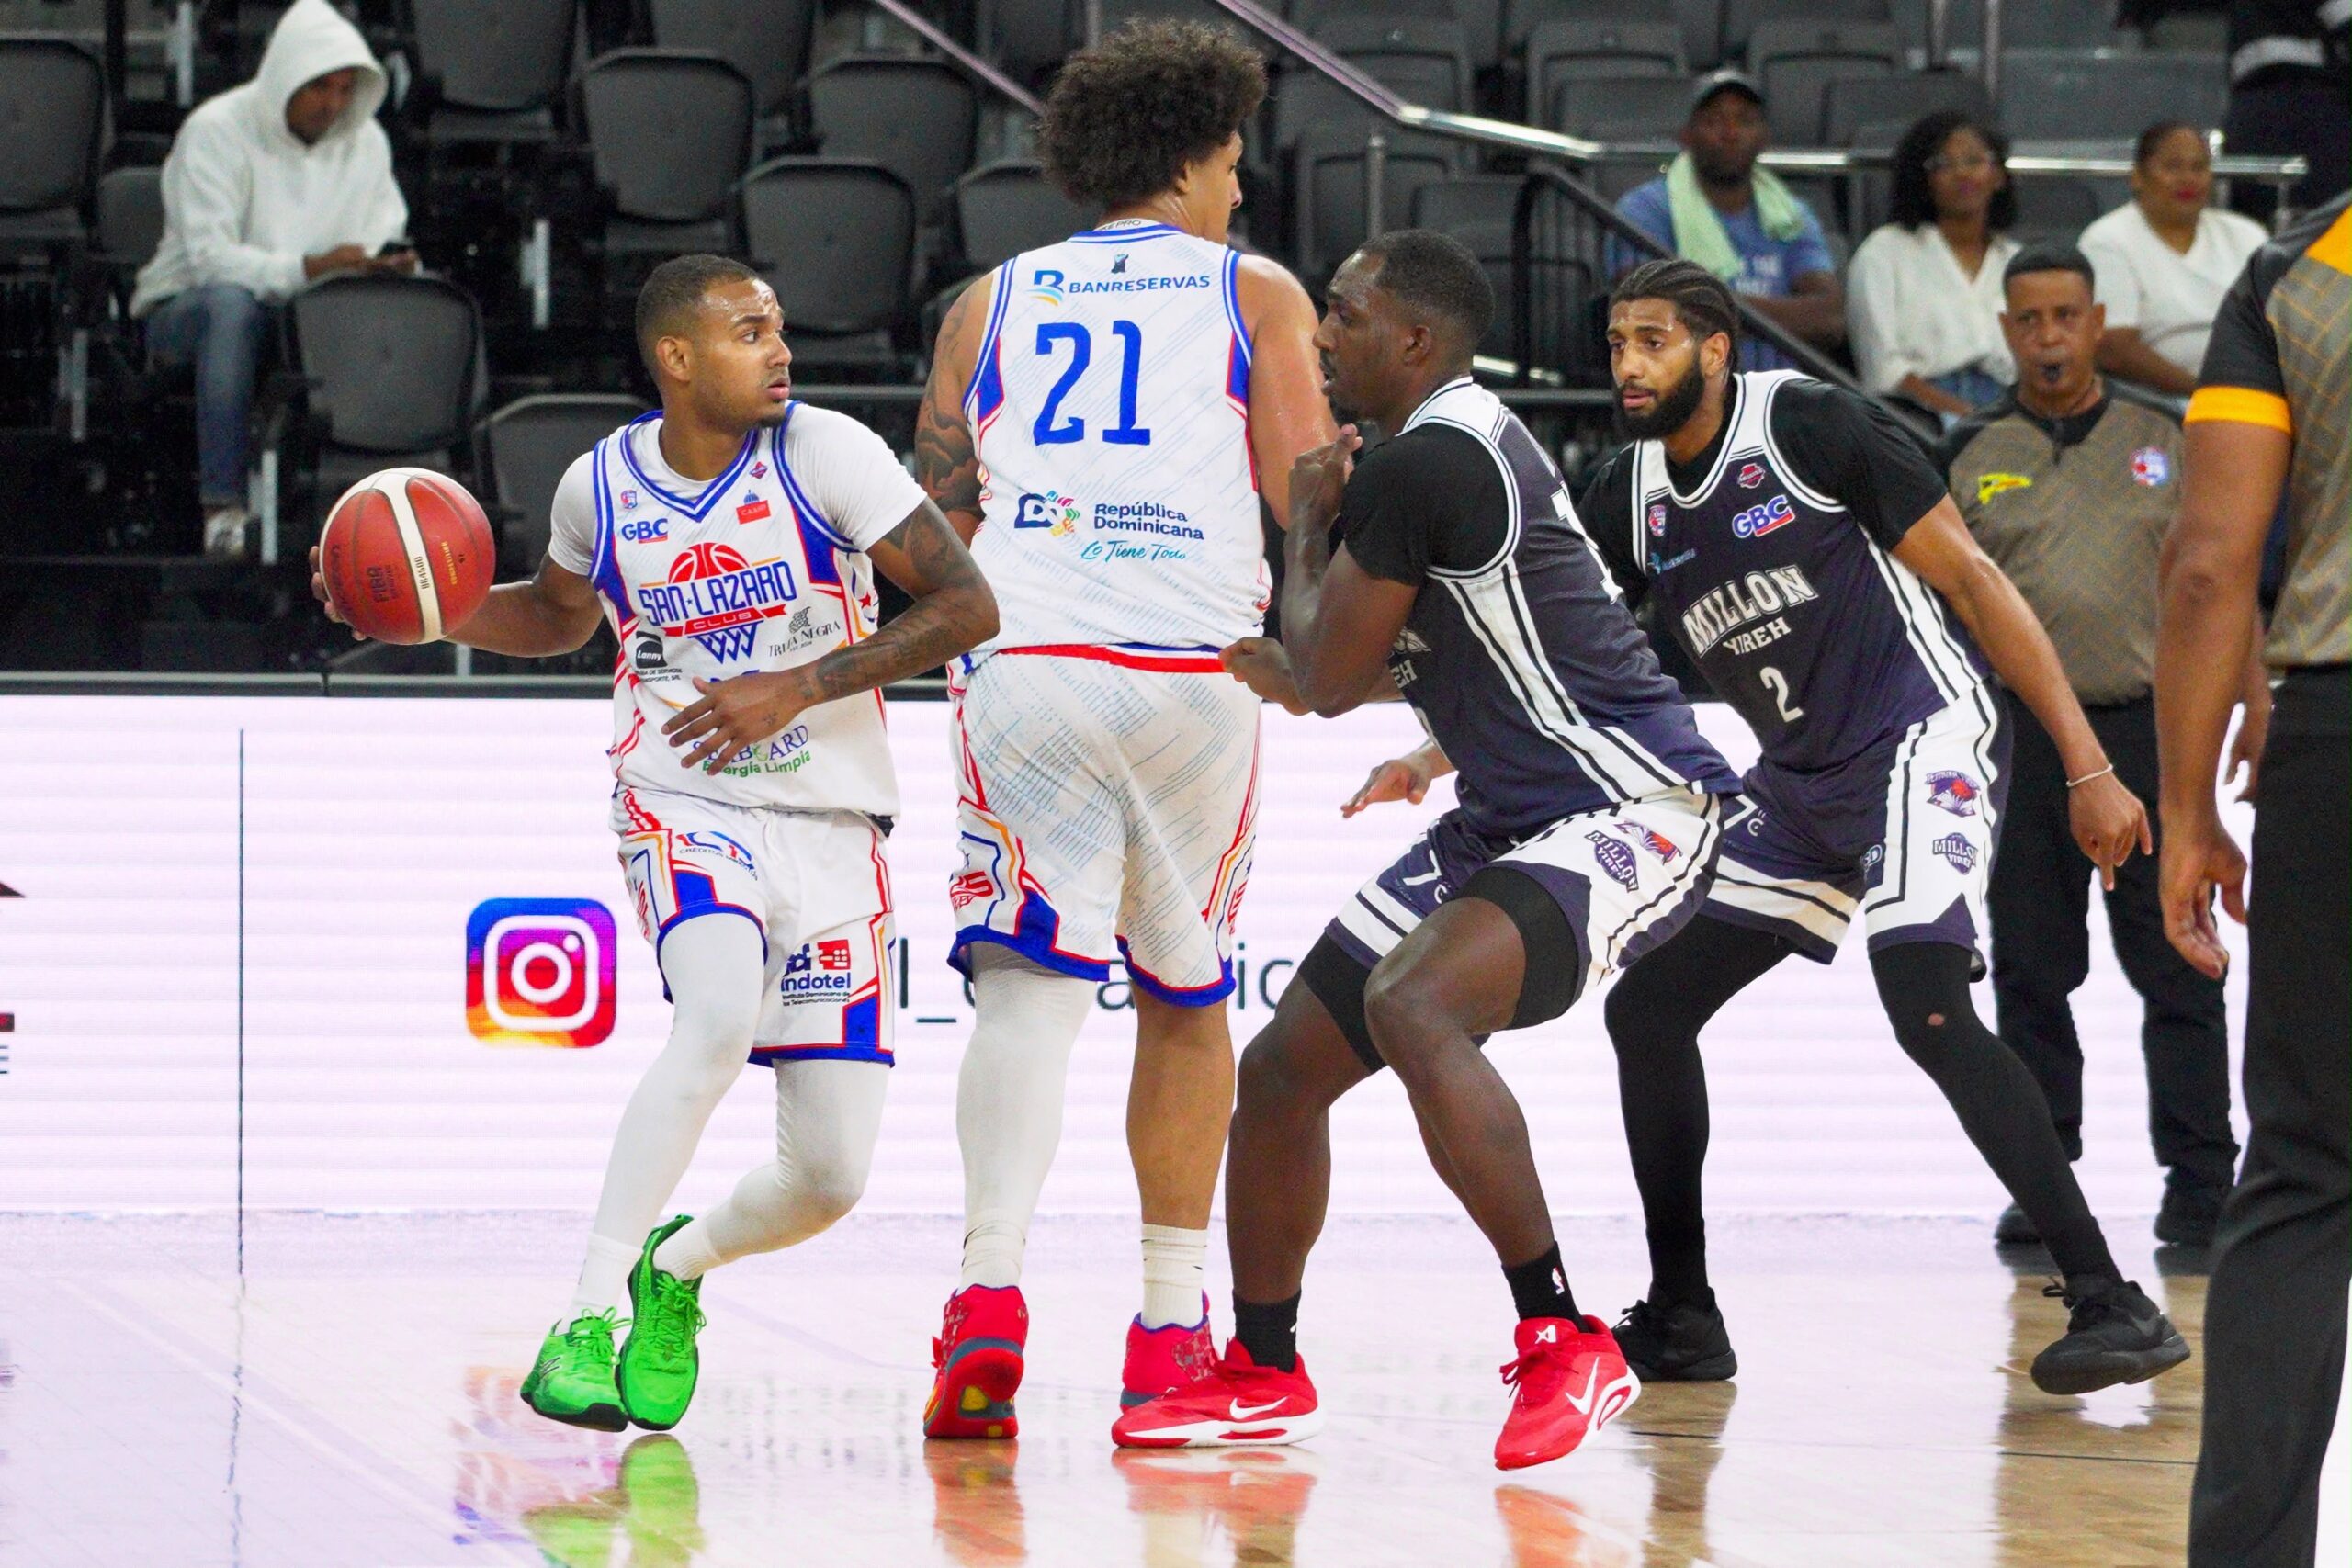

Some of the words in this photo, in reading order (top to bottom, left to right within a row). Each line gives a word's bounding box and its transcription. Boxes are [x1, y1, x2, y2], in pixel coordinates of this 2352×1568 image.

[1069, 275, 1211, 294] BANRESERVAS
[1032, 319, 1151, 446] 21
[1094, 501, 1189, 523] República
[1732, 495, 1792, 538] GBC
[620, 517, 669, 542] GBC
[1093, 515, 1205, 540] Dominicana
[1105, 539, 1148, 563] Tiene
[637, 585, 689, 626] SAN
[690, 560, 798, 616] LAZARO
[692, 610, 752, 630] CLUB
[1681, 564, 1820, 659] MILLON
[637, 650, 662, 662] Lanny
[1759, 666, 1805, 723] 2
[702, 760, 761, 778] Eergía
[764, 750, 811, 773] Limpia
[780, 971, 851, 992] indotel
